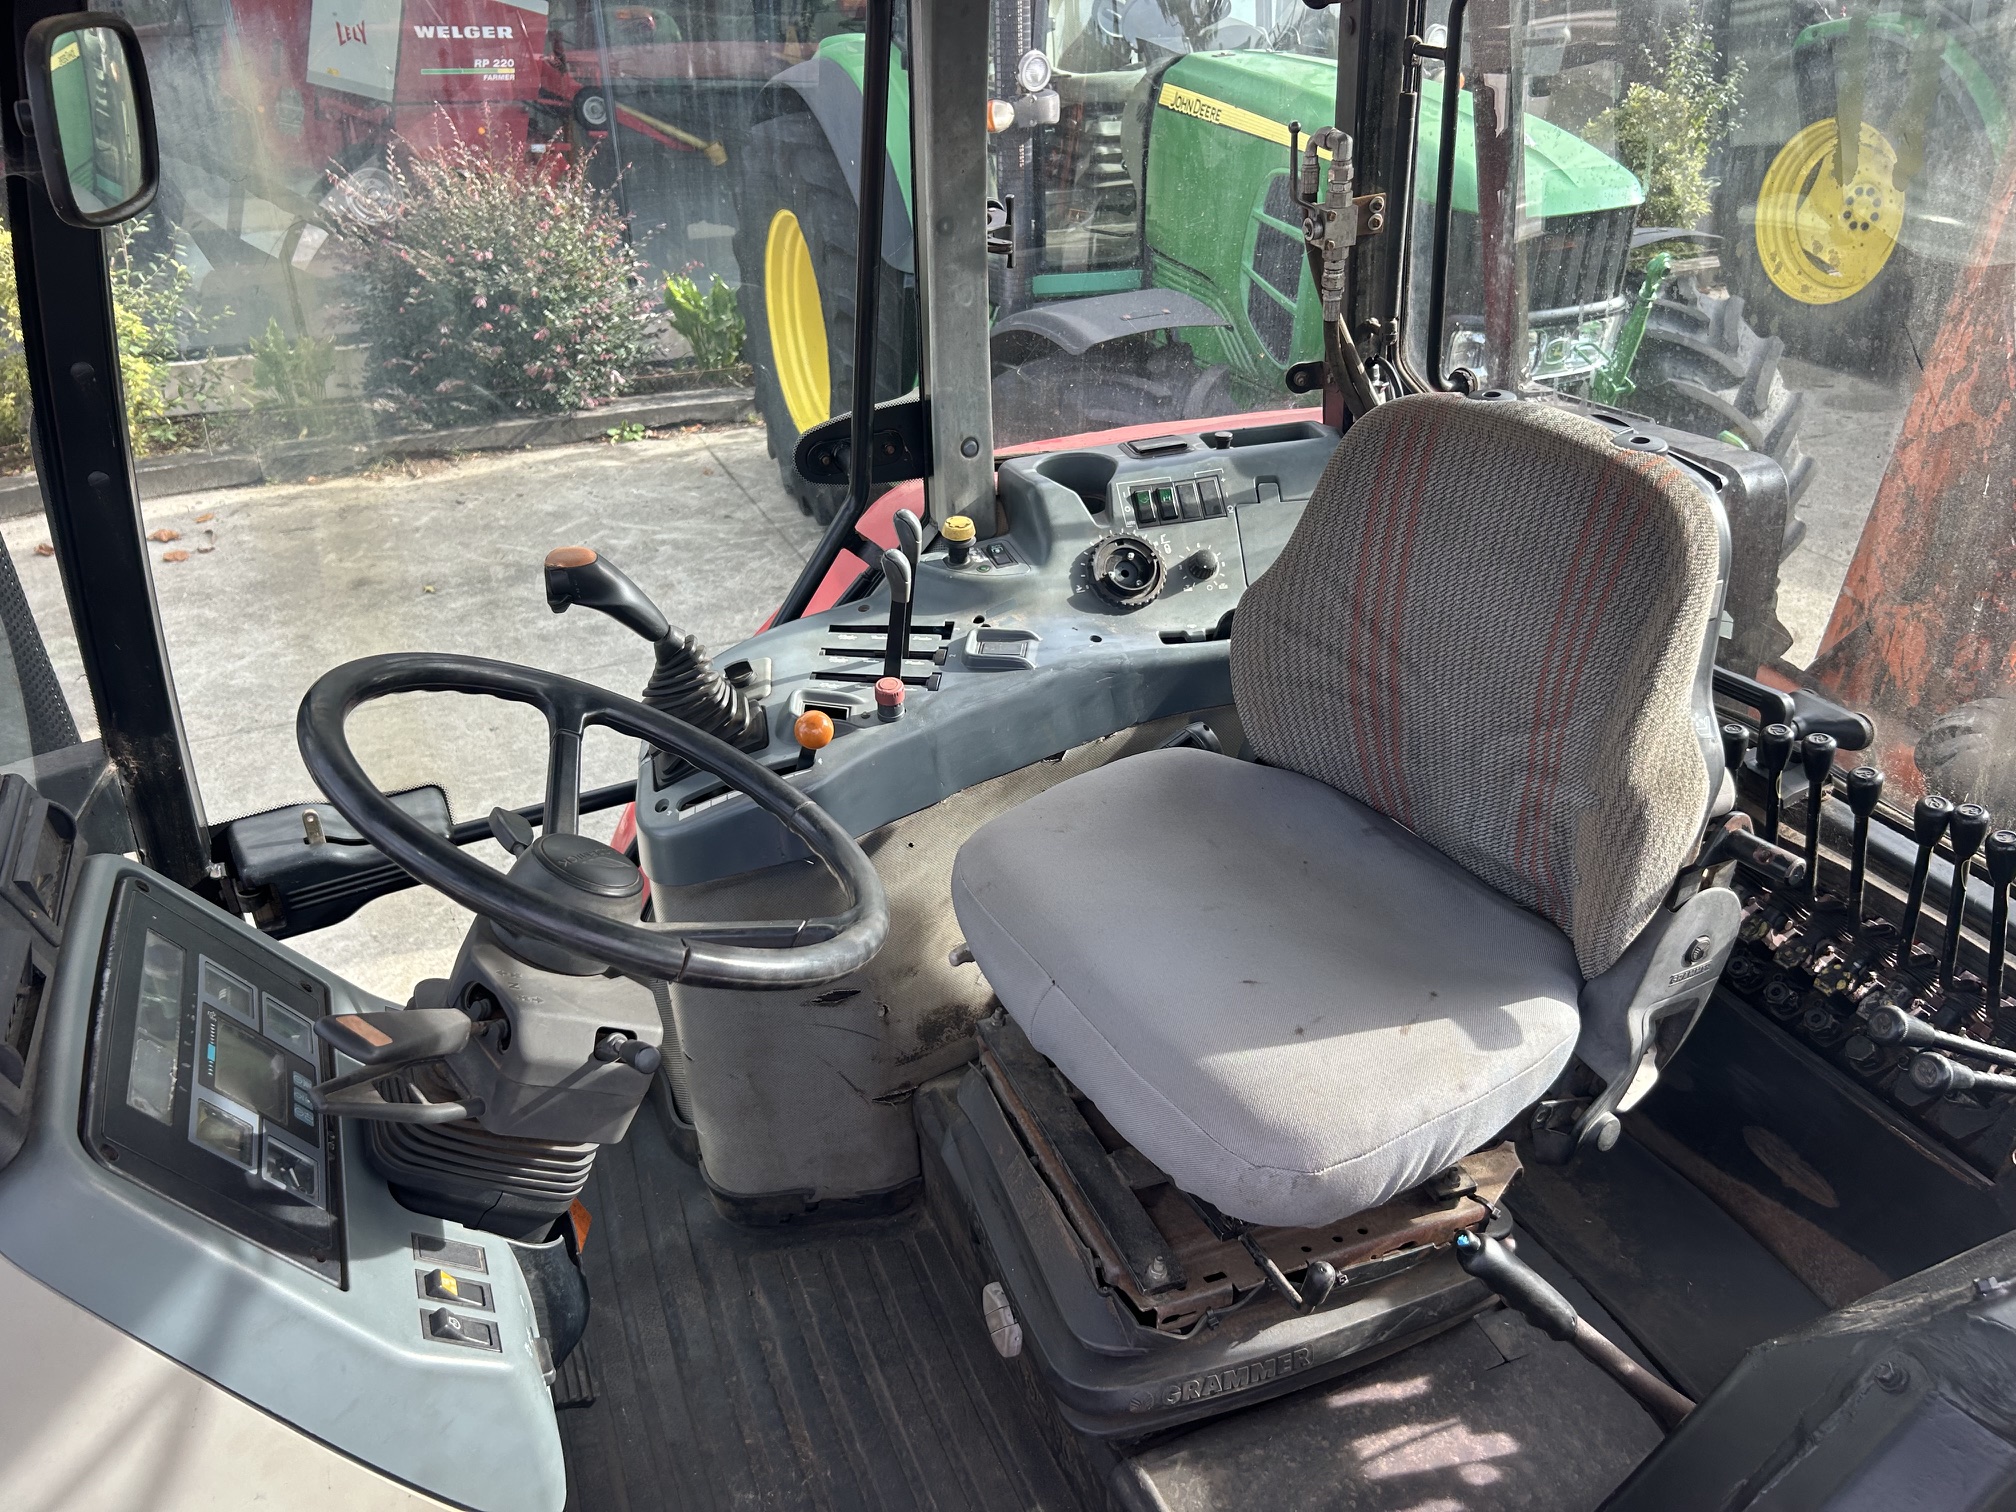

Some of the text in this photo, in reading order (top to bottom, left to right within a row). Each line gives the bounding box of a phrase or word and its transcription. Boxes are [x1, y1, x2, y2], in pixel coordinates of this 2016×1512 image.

[335, 20, 367, 46] LELY
[413, 25, 514, 39] WELGER
[474, 58, 515, 68] RP 220
[1162, 1346, 1312, 1405] GRAMMER
